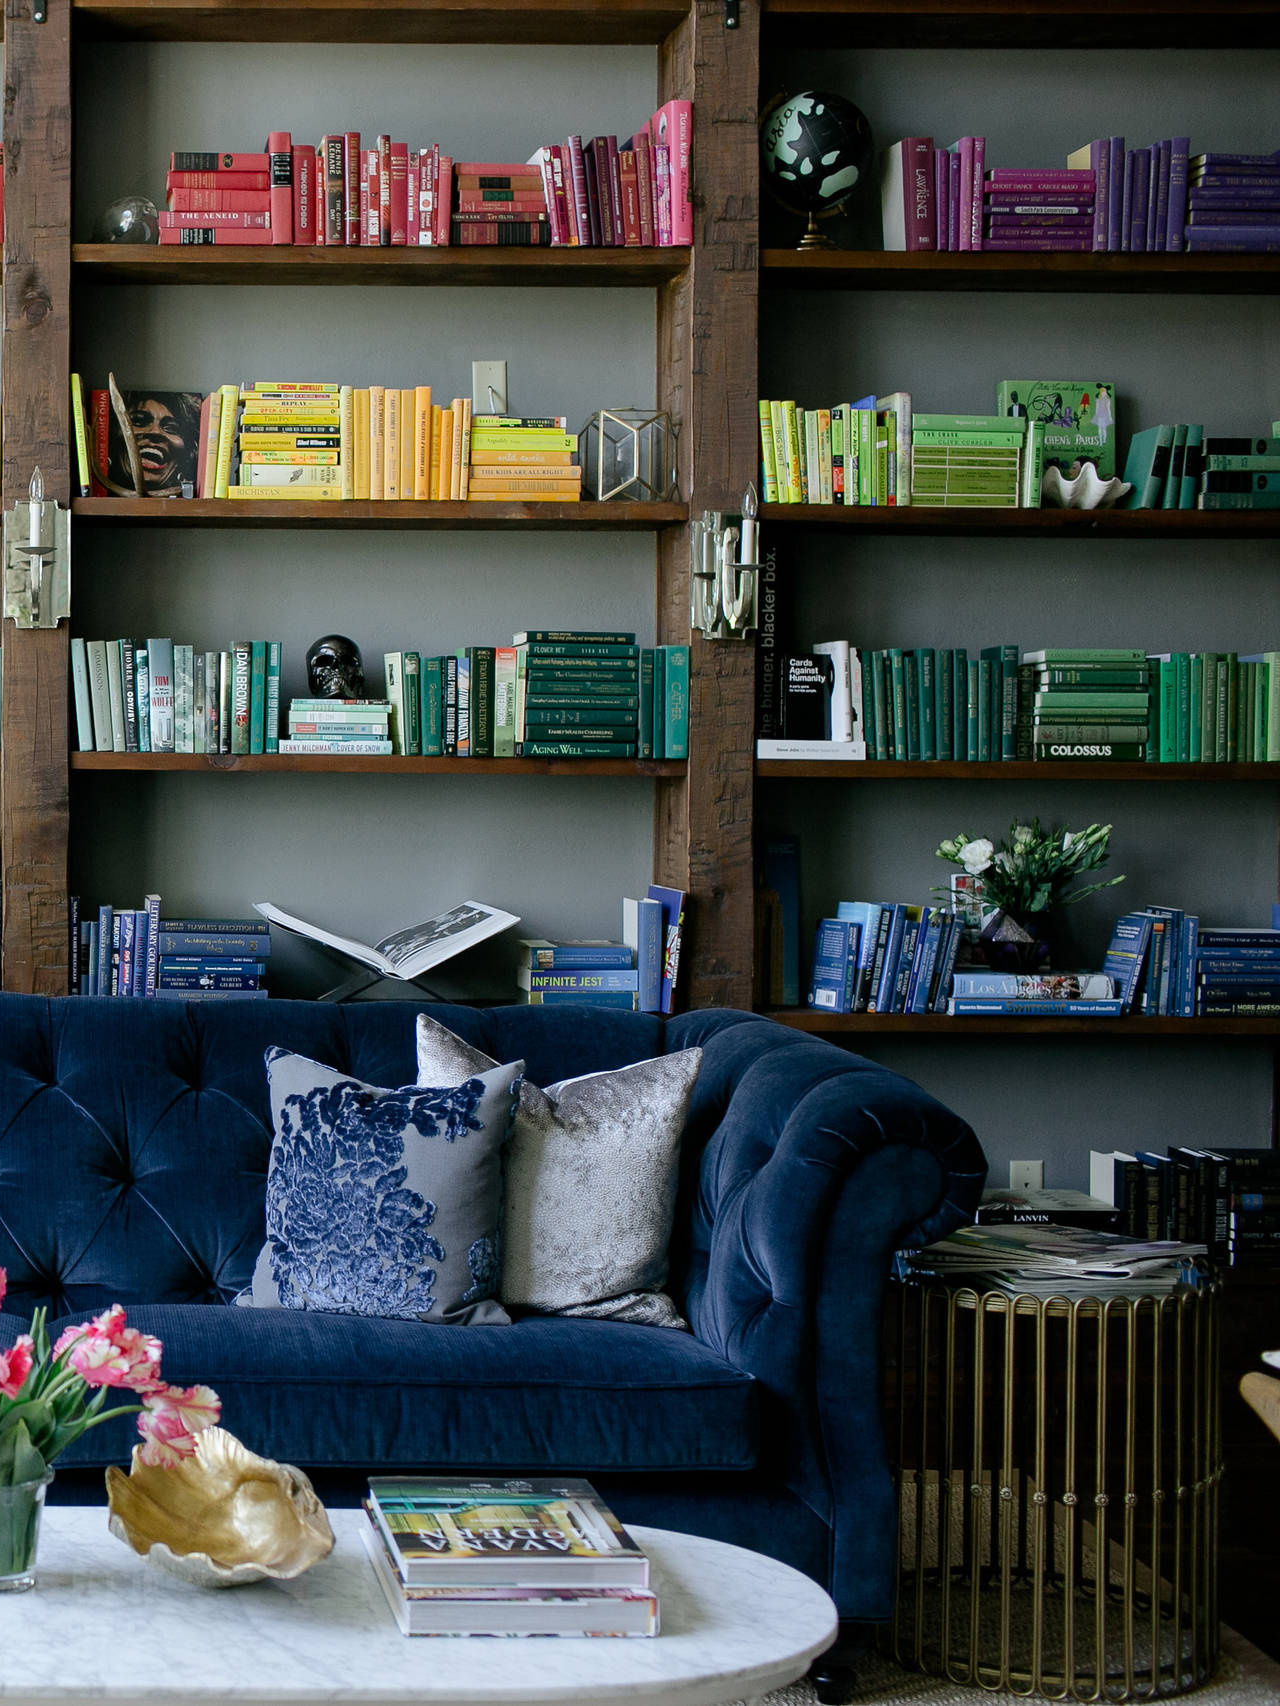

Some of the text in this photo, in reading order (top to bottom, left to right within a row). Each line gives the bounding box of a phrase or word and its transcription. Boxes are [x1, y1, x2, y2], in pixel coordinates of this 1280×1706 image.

[916, 169, 928, 220] LAWRENCE
[776, 430, 784, 466] BIG SHIFT
[1074, 434, 1099, 445] PARIS
[764, 546, 777, 583] box.
[762, 587, 775, 648] blacker
[94, 648, 104, 691] ADMISSION
[125, 651, 134, 680] HOMER
[789, 659, 813, 667] Cards
[789, 667, 818, 675] Against
[154, 676, 169, 687] TOM
[236, 653, 248, 716] DAN BROWN
[789, 674, 826, 683] Humanity
[126, 691, 135, 723] ODYSSEY
[151, 697, 173, 707] WOLFE
[447, 660, 455, 745] THOMAS PYNCHON BLEEDING EDGE
[479, 661, 488, 742] FROM HERE TO ETERNITY
[497, 682, 506, 726] MATTERHORN
[671, 682, 682, 723] CATHER
[459, 710, 468, 740] FRANZEN
[281, 744, 299, 752] JENNY
[301, 744, 331, 752] MILCHMAN
[530, 745, 582, 754] AGING WELL
[1050, 745, 1112, 756] COLOSSUS
[147, 906, 158, 991] LITERARY GOURMET
[908, 929, 917, 951] BRIDGE
[134, 936, 144, 993] HOSTAGE THREE
[865, 939, 876, 981] MOUNTAIN
[532, 976, 603, 987] INFINITE JEST
[901, 971, 910, 995] RICHARD
[968, 979, 1051, 997] Los Angeles
[1005, 1001, 1067, 1015] Swimsuit
[1013, 1214, 1049, 1223] LANVIN
